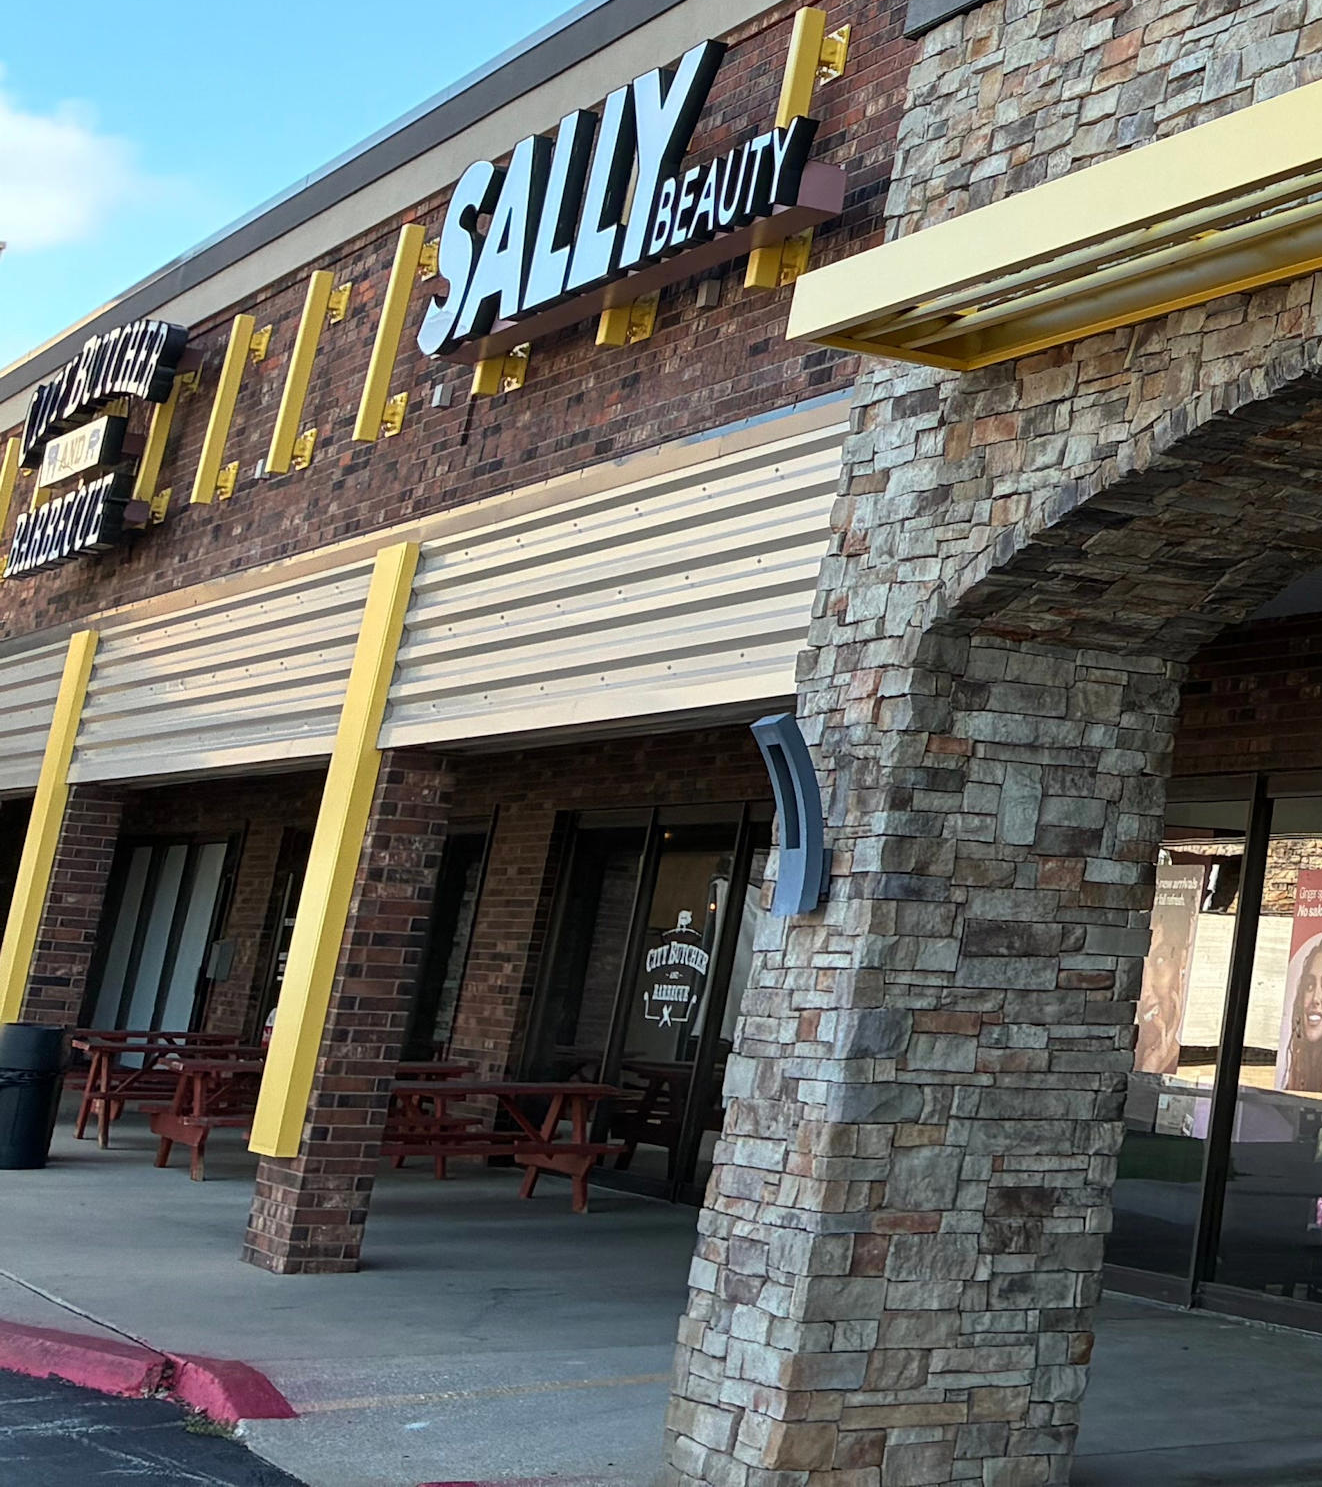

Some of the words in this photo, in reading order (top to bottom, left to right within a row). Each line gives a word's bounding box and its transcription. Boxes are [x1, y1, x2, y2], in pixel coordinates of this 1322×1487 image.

[416, 39, 710, 358] SALLY
[648, 116, 802, 256] BEAUTY
[63, 319, 170, 420] BUTCHER
[3, 471, 116, 578] BARBECUE
[647, 945, 670, 972] CITY
[668, 941, 709, 975] BUTCHER
[1296, 904, 1308, 917] No
